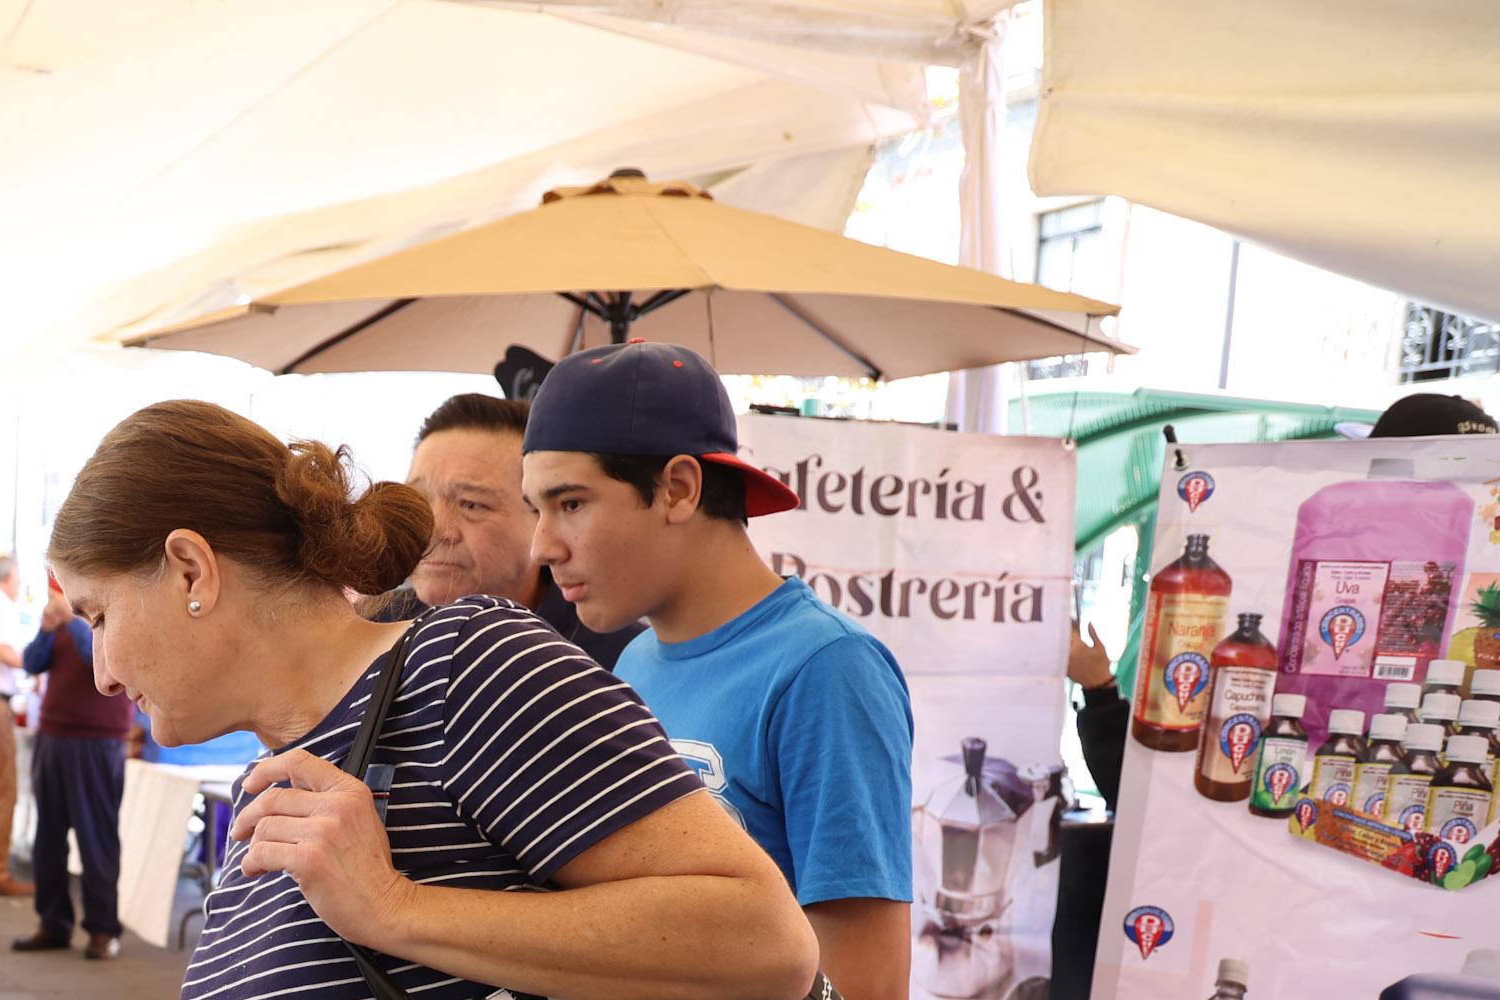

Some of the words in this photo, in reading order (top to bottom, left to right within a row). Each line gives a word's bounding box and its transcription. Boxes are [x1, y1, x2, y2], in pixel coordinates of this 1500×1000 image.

[740, 453, 985, 522] fetería
[1002, 464, 1046, 524] &
[1335, 580, 1361, 595] Uva
[1453, 799, 1475, 812] Piña
